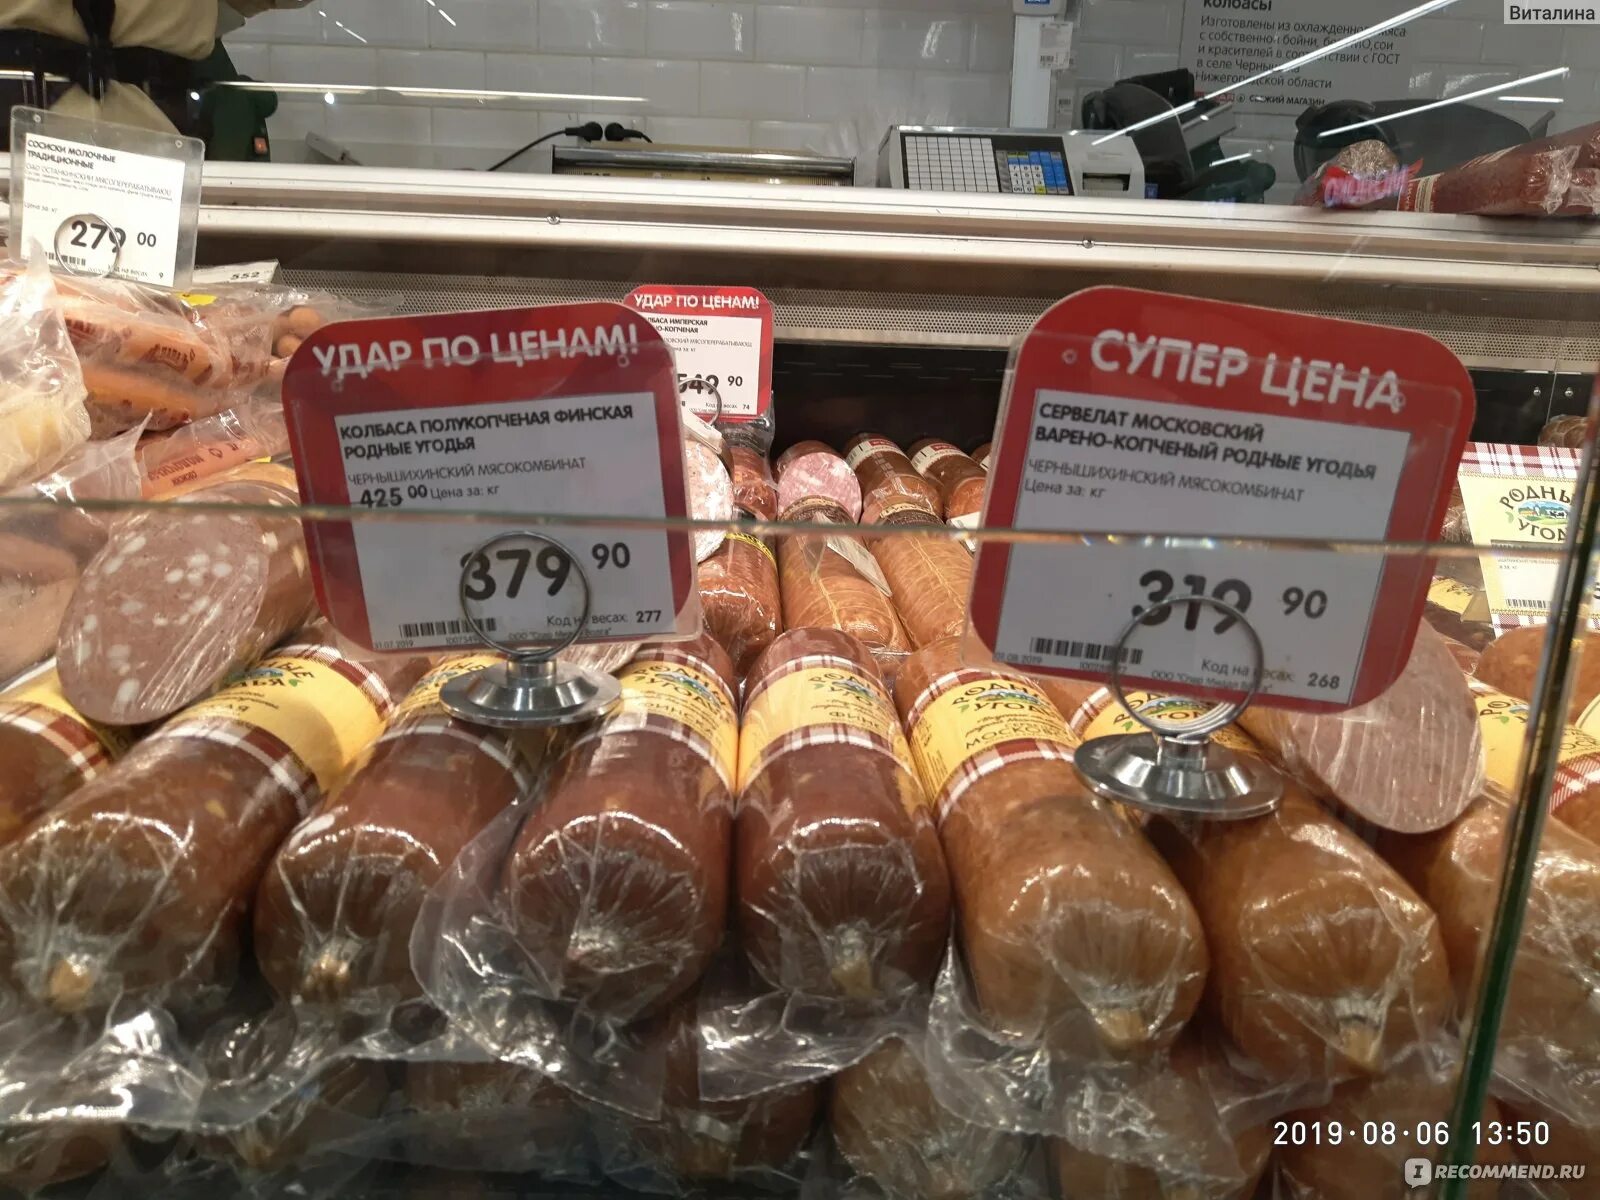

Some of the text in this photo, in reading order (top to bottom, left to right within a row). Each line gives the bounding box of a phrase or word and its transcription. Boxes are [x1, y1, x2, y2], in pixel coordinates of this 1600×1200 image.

[1200, 16, 1275, 30] Изготовлены
[1278, 22, 1291, 31] из
[1293, 23, 1371, 35] охлажденно
[1200, 31, 1206, 41] с
[1197, 59, 1300, 74] в селе Черныа
[1198, 45, 1205, 54] и
[1208, 46, 1274, 58] красителей
[1362, 55, 1369, 64] с
[1371, 52, 1401, 65] ГОСТ
[1195, 71, 1333, 89] Нижегордской области
[27, 139, 116, 164] СОСИСКИ МОЛОЧНЫЕ
[27, 150, 95, 170] ТРАДИЦИОННЫЕ
[70, 219, 157, 254] 279 00
[633, 293, 761, 310] УДАР ПО ЦЕНАМ!
[669, 318, 708, 327] ИМПЕРСКАЯ
[311, 322, 639, 381] УДАР ПО ЦЕНАМ!
[727, 376, 744, 387] 90
[1090, 328, 1402, 414] СУПЕР ЦЕНА
[340, 405, 634, 440] КОЛБАСА ПОЛУКОПЧЕНАЯ ФИНСКАЯ
[1038, 402, 1265, 442] СЕРВЕЛАТ МОСКОВСКИЙ
[344, 436, 476, 460] РОДНЫЕ УГОДЬЯ
[1034, 426, 1377, 481] ВАРЕНО-КОПЧЕНЫЙ РОДНЫЕ УГОДЬЯ
[347, 456, 587, 486] ЧЕРНЫШИХИНСКИЙ МЯСОКОМБИНАТ
[1028, 458, 1305, 502] ЧЕРНЫШИХИНСКИЙ МЯСОКОМБИНАТ
[359, 484, 500, 509] 425 00 Цена за: кг
[1023, 479, 1106, 499] Цена за: кг
[1499, 485, 1572, 510] РОДНЫ
[1518, 518, 1568, 542] УГОД
[459, 541, 631, 602] 379 90
[1131, 569, 1328, 635] 319 90
[546, 614, 571, 628] Код
[635, 610, 662, 624] 277
[1200, 658, 1229, 676] Код
[1232, 664, 1250, 676] на
[1307, 671, 1341, 690] 268
